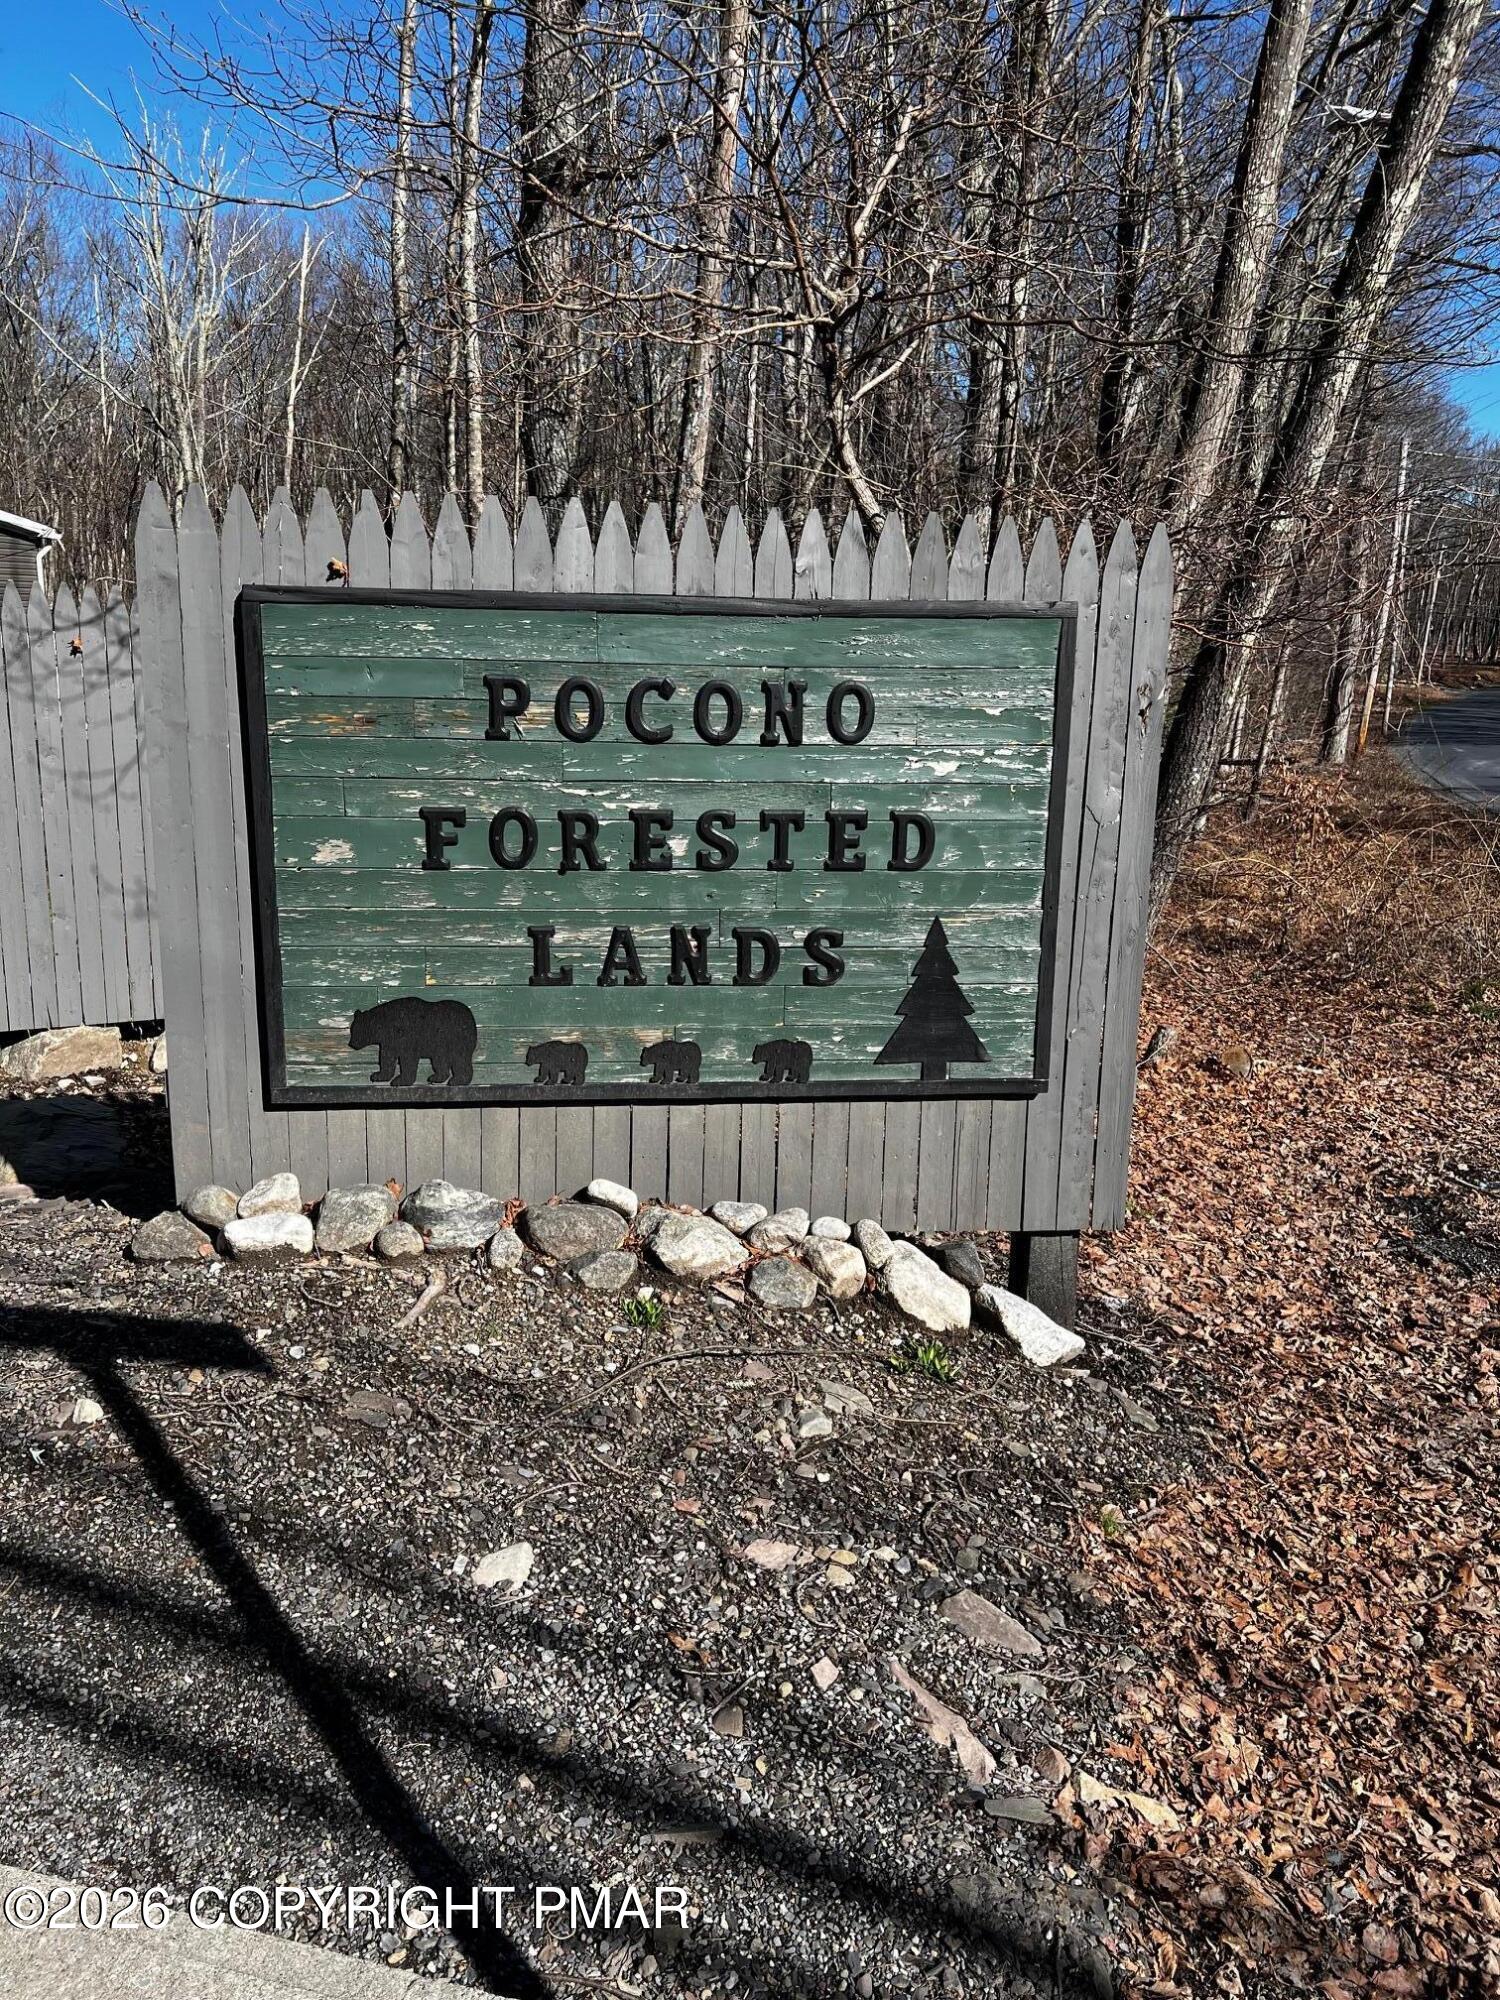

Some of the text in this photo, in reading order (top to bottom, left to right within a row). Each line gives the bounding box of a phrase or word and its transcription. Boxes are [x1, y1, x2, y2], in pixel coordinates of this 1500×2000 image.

[483, 674, 875, 746] POCONO
[419, 805, 935, 874] FORESTED
[527, 925, 846, 987] LANDS
